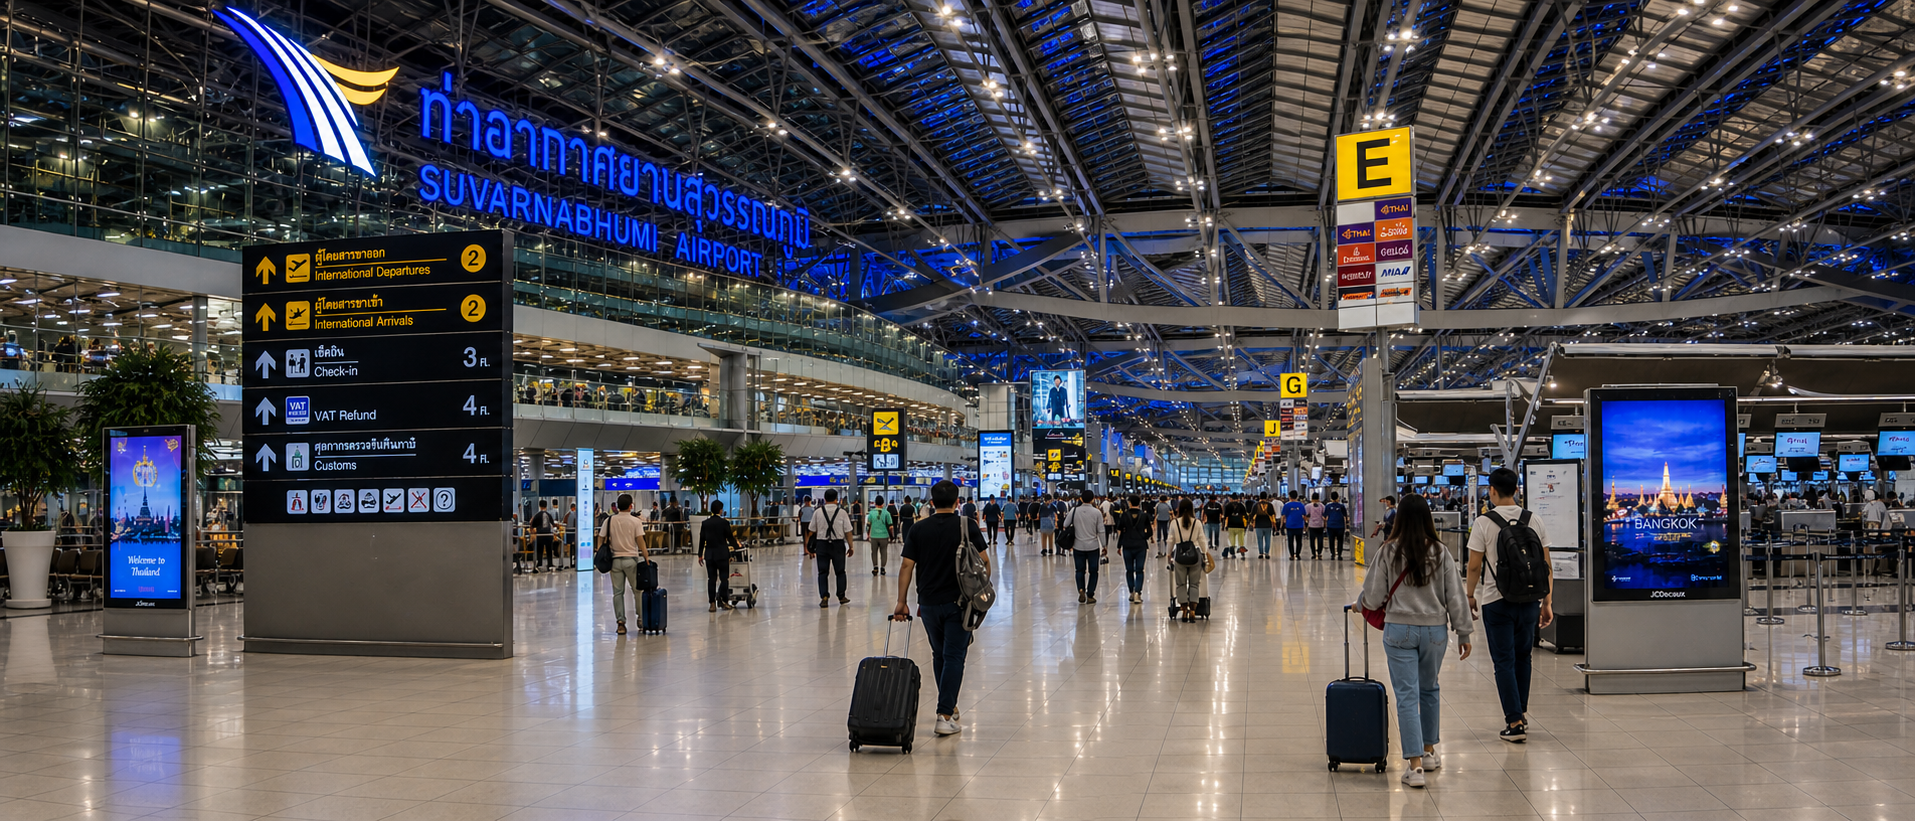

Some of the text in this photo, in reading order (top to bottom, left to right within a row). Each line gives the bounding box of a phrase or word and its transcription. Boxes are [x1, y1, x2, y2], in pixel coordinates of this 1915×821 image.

[1357, 138, 1392, 190] E
[419, 164, 763, 278] SUVARNABHUMI AIRPORT
[468, 250, 479, 266] 2
[315, 265, 431, 281] International Departures
[468, 300, 479, 316] 2
[315, 315, 414, 330] International Arrivals
[463, 346, 477, 368] 3
[314, 365, 358, 378] Check-in
[1286, 376, 1302, 394] G
[289, 401, 306, 411] VAT
[462, 394, 477, 416] 4
[314, 410, 337, 422] VAT
[340, 409, 377, 421] Refund
[1269, 422, 1277, 435] J
[462, 442, 477, 464] 4
[314, 460, 357, 471] Customs
[1634, 517, 1698, 530] BANGKOK
